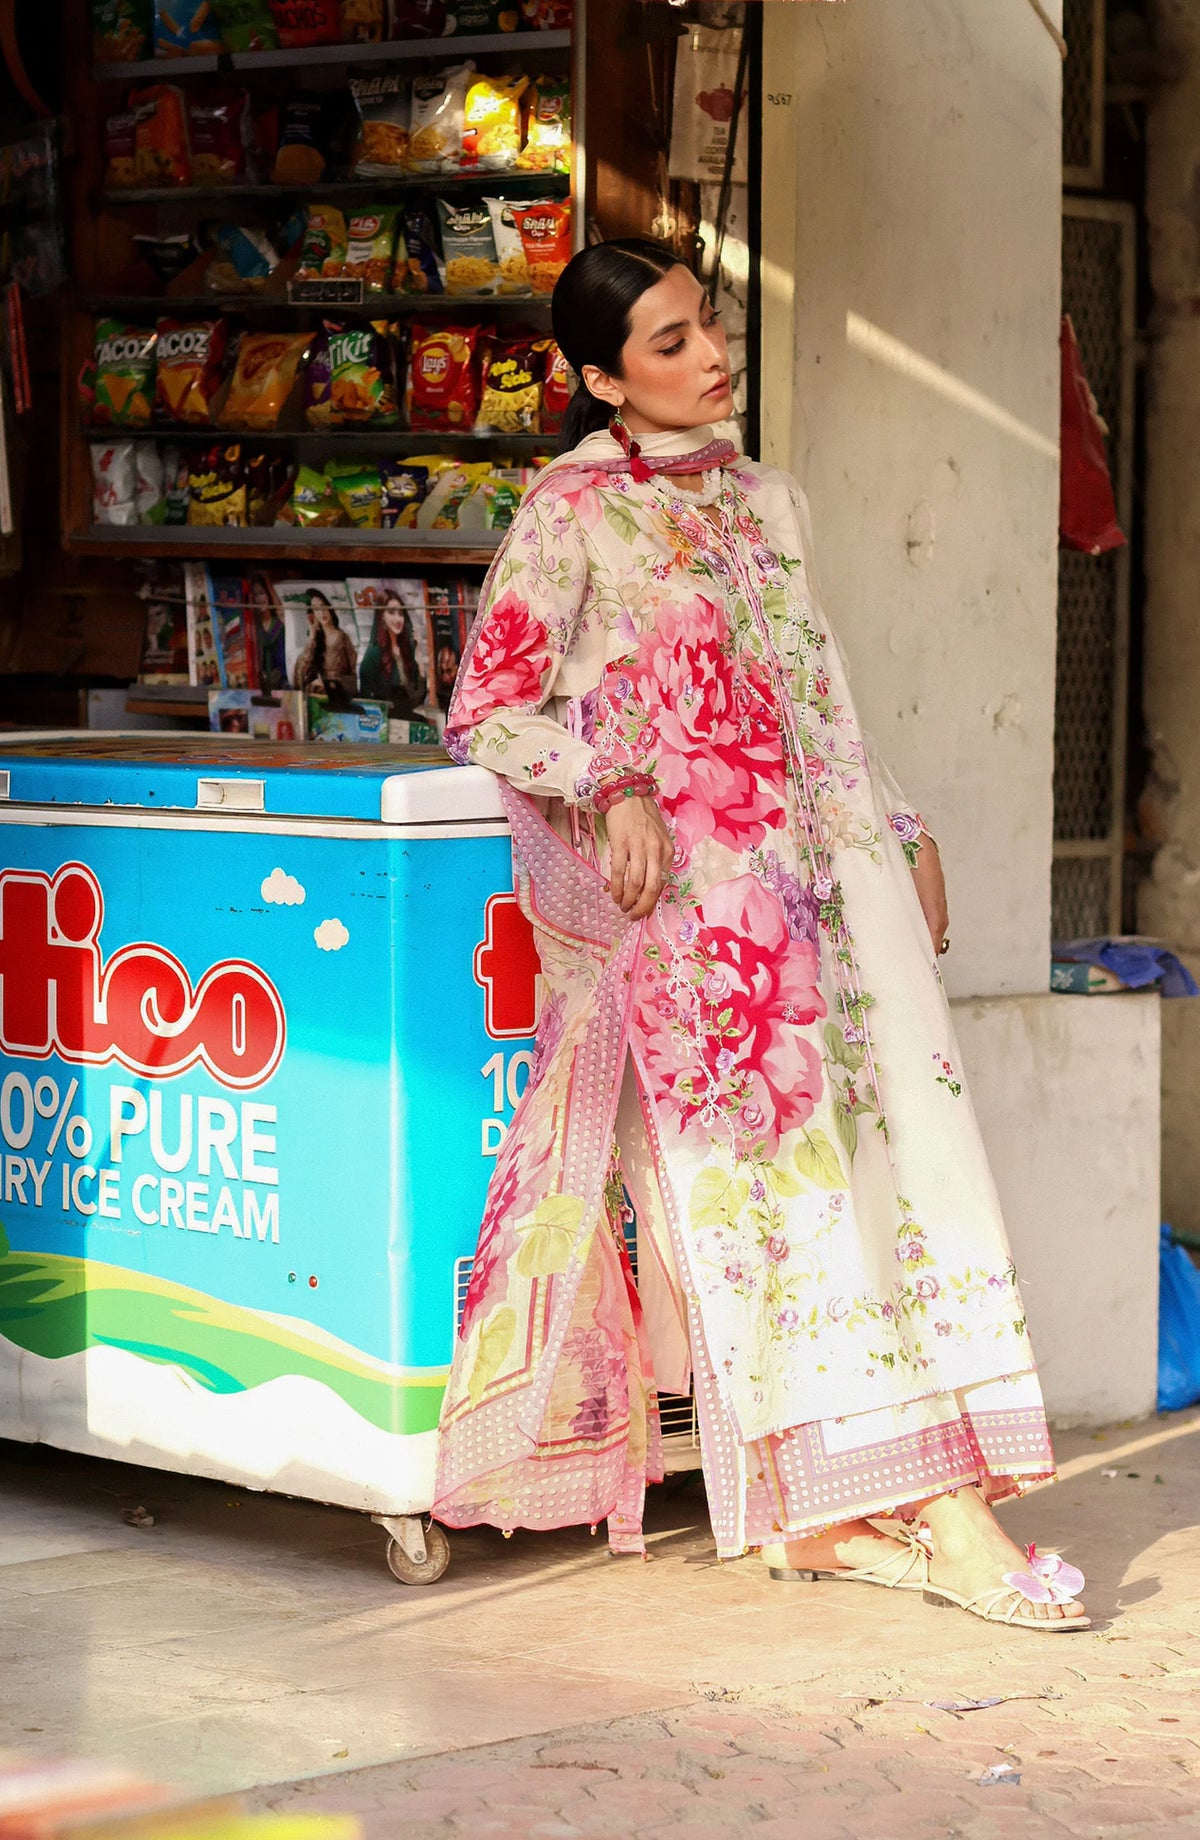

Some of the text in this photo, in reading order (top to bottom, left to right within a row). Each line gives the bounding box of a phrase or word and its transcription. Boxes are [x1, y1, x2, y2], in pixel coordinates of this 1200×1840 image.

[110, 1084, 279, 1186] PURE
[62, 1163, 122, 1220] ICE
[131, 1173, 280, 1245] CREAM
